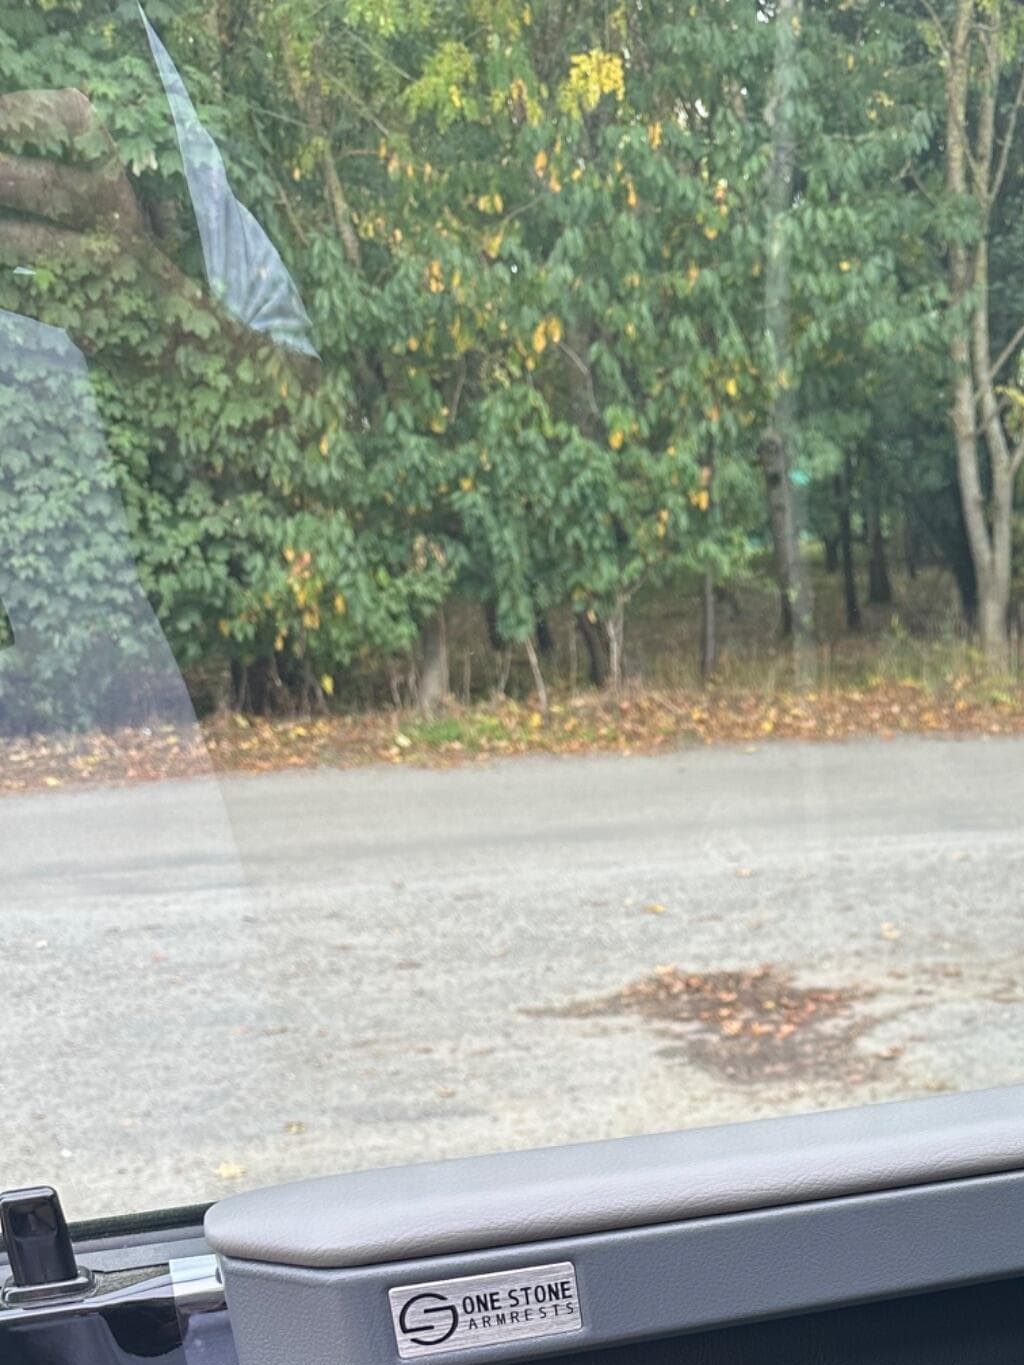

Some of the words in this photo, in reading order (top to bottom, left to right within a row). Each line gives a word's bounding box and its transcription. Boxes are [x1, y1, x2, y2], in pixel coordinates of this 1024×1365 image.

[462, 1292, 501, 1315] ONE
[507, 1281, 573, 1307] STONE
[469, 1302, 574, 1330] ARMRESTS
